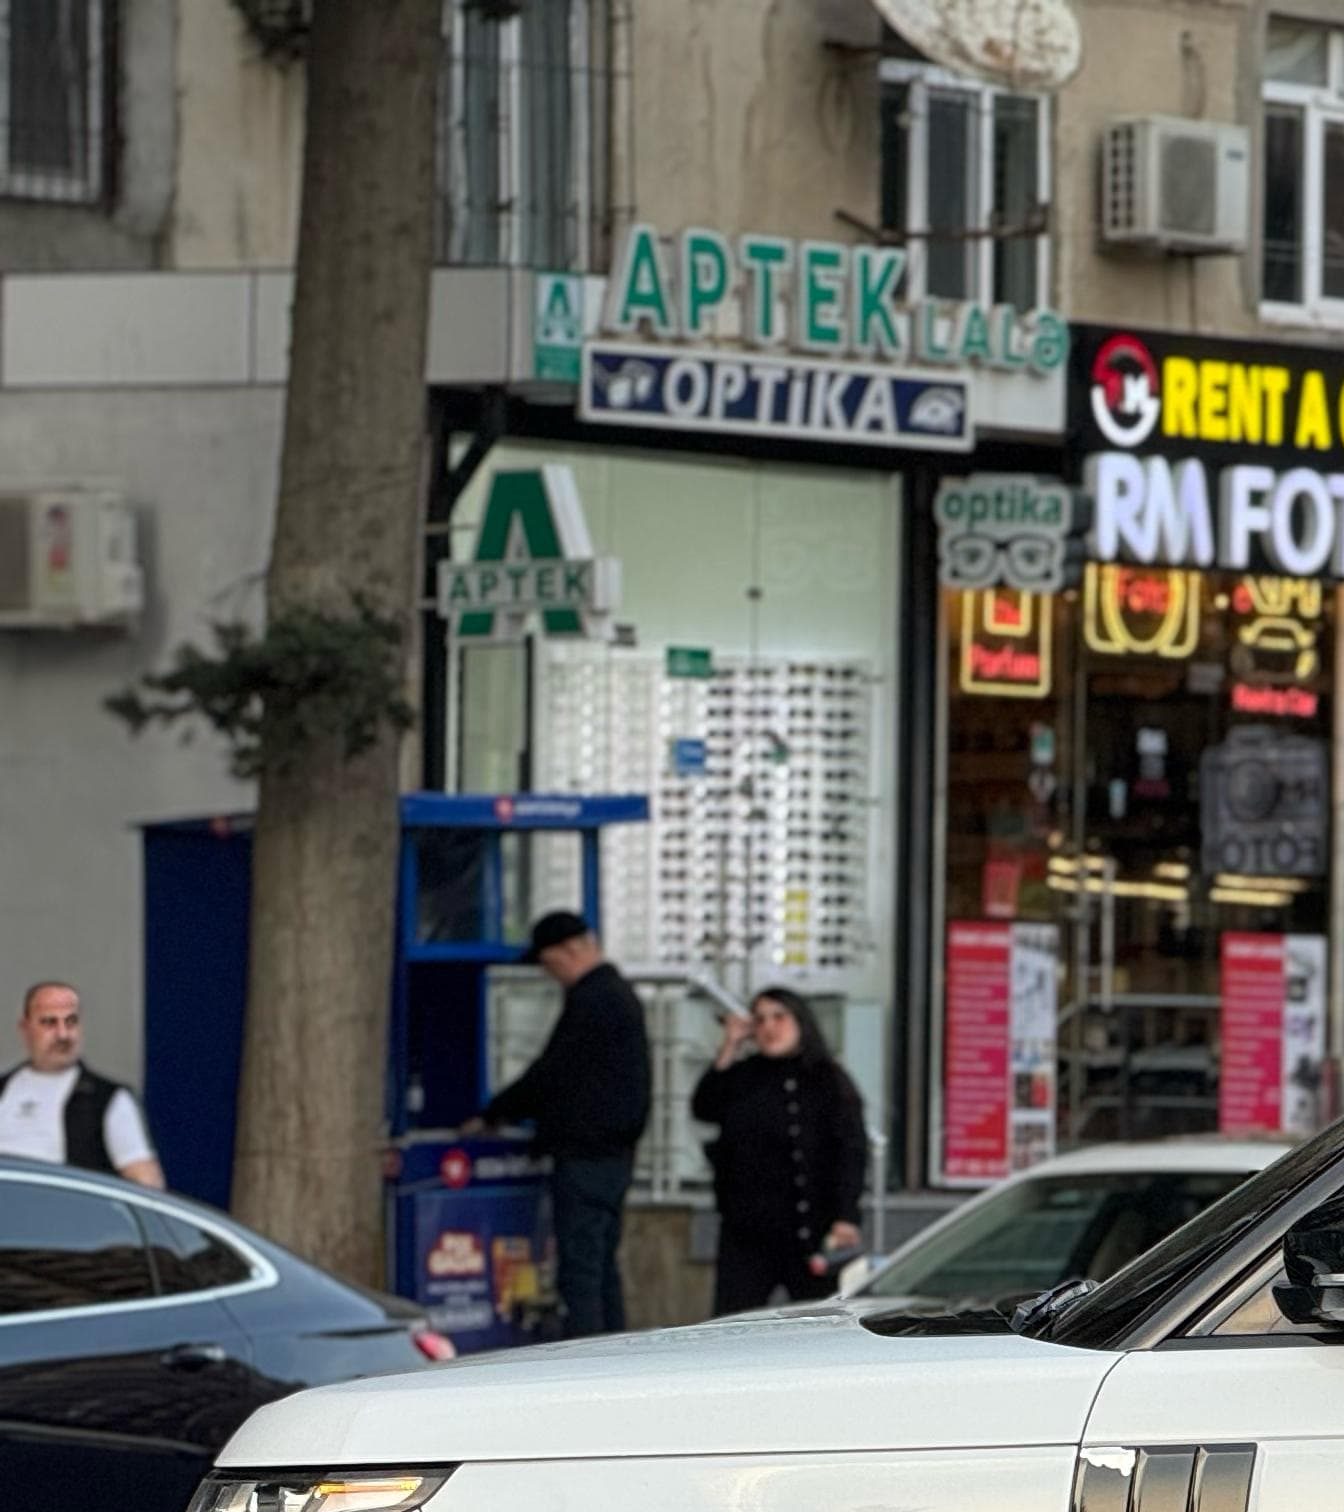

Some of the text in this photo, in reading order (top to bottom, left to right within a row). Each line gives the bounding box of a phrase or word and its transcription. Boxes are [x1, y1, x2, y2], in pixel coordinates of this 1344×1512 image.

[617, 226, 903, 352] APTEK
[1161, 355, 1290, 446] RENT
[1295, 370, 1332, 450] A
[943, 484, 1063, 531] optika
[1090, 452, 1216, 567] RM
[449, 566, 591, 600] APTEK
